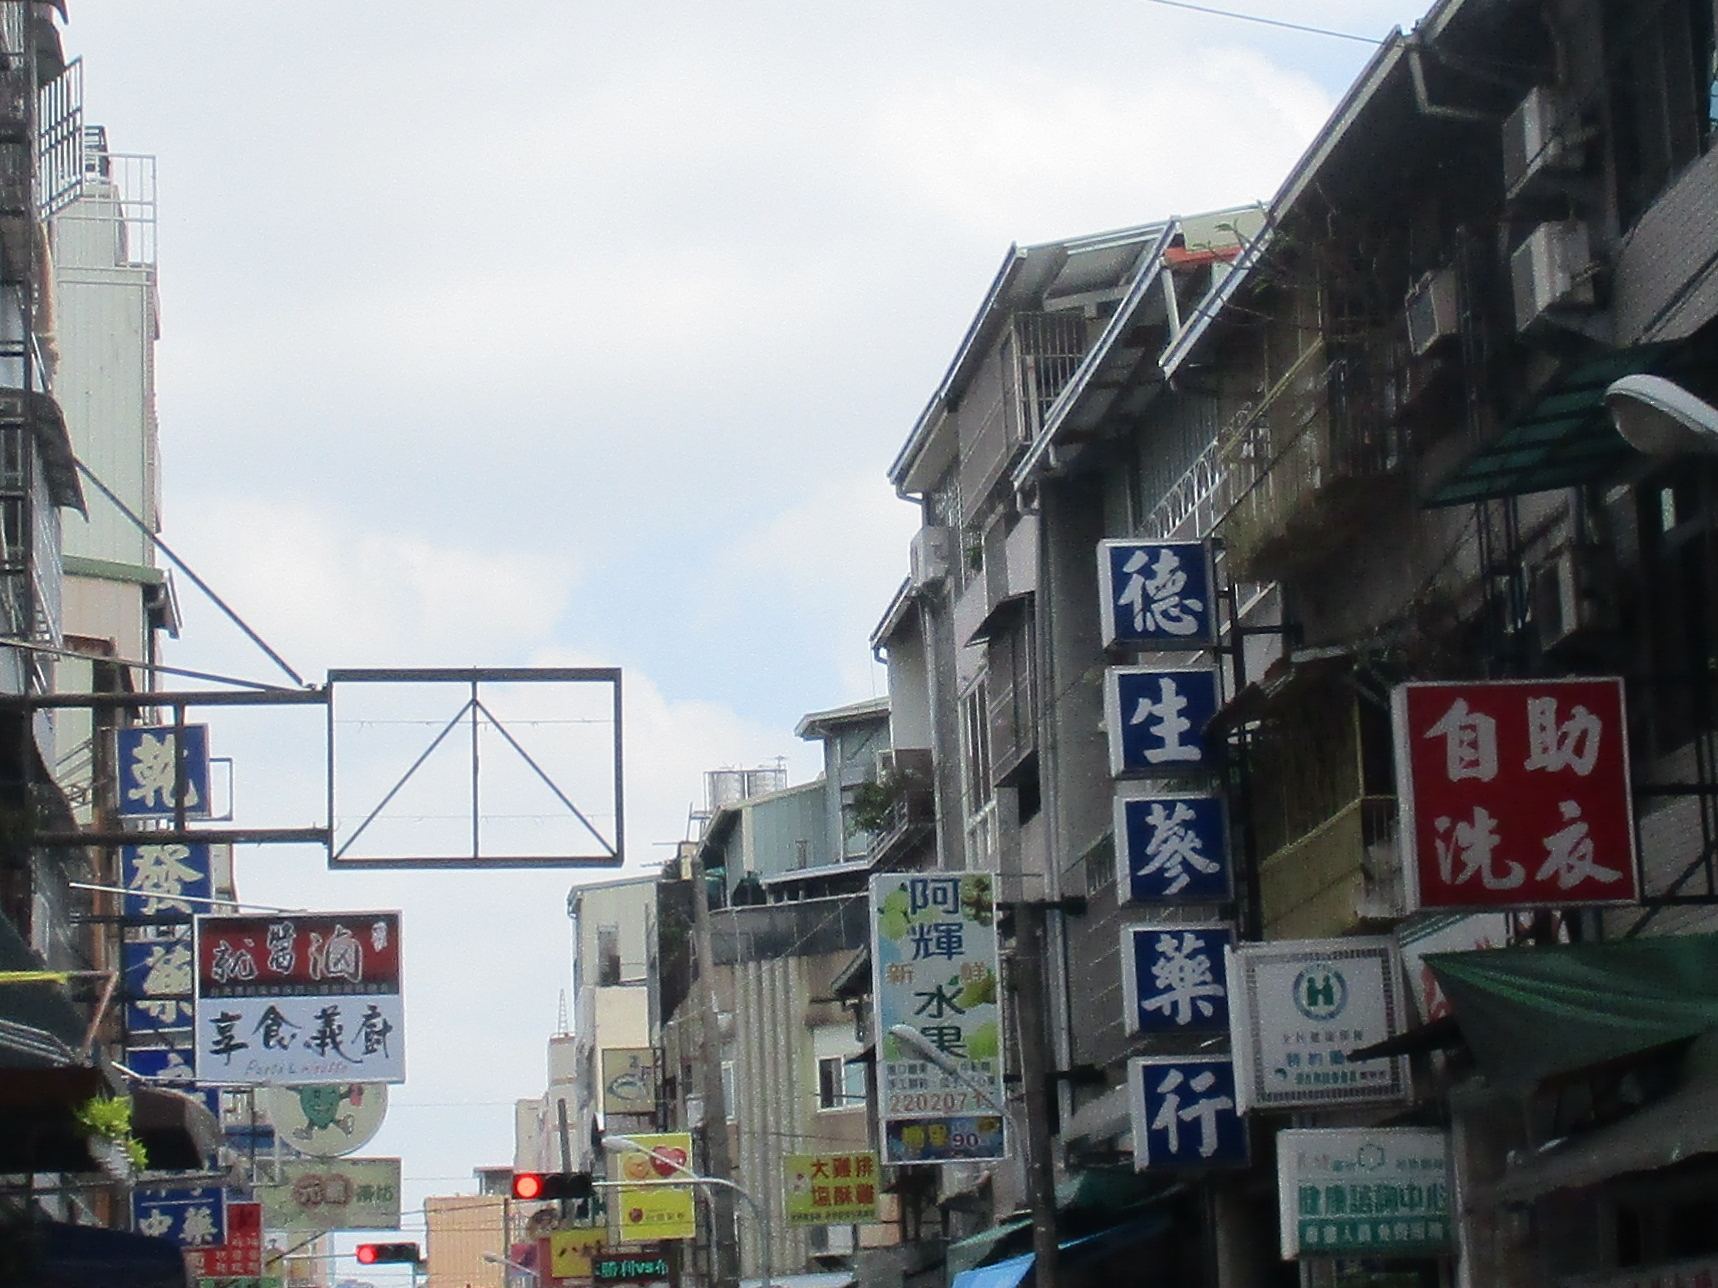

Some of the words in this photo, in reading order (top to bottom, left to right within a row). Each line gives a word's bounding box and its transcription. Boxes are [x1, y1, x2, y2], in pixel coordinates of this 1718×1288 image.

[1423, 695, 1603, 785] 自助
[1119, 548, 1233, 1158] 德生蔘藥行
[1433, 802, 1624, 892] 洗衣
